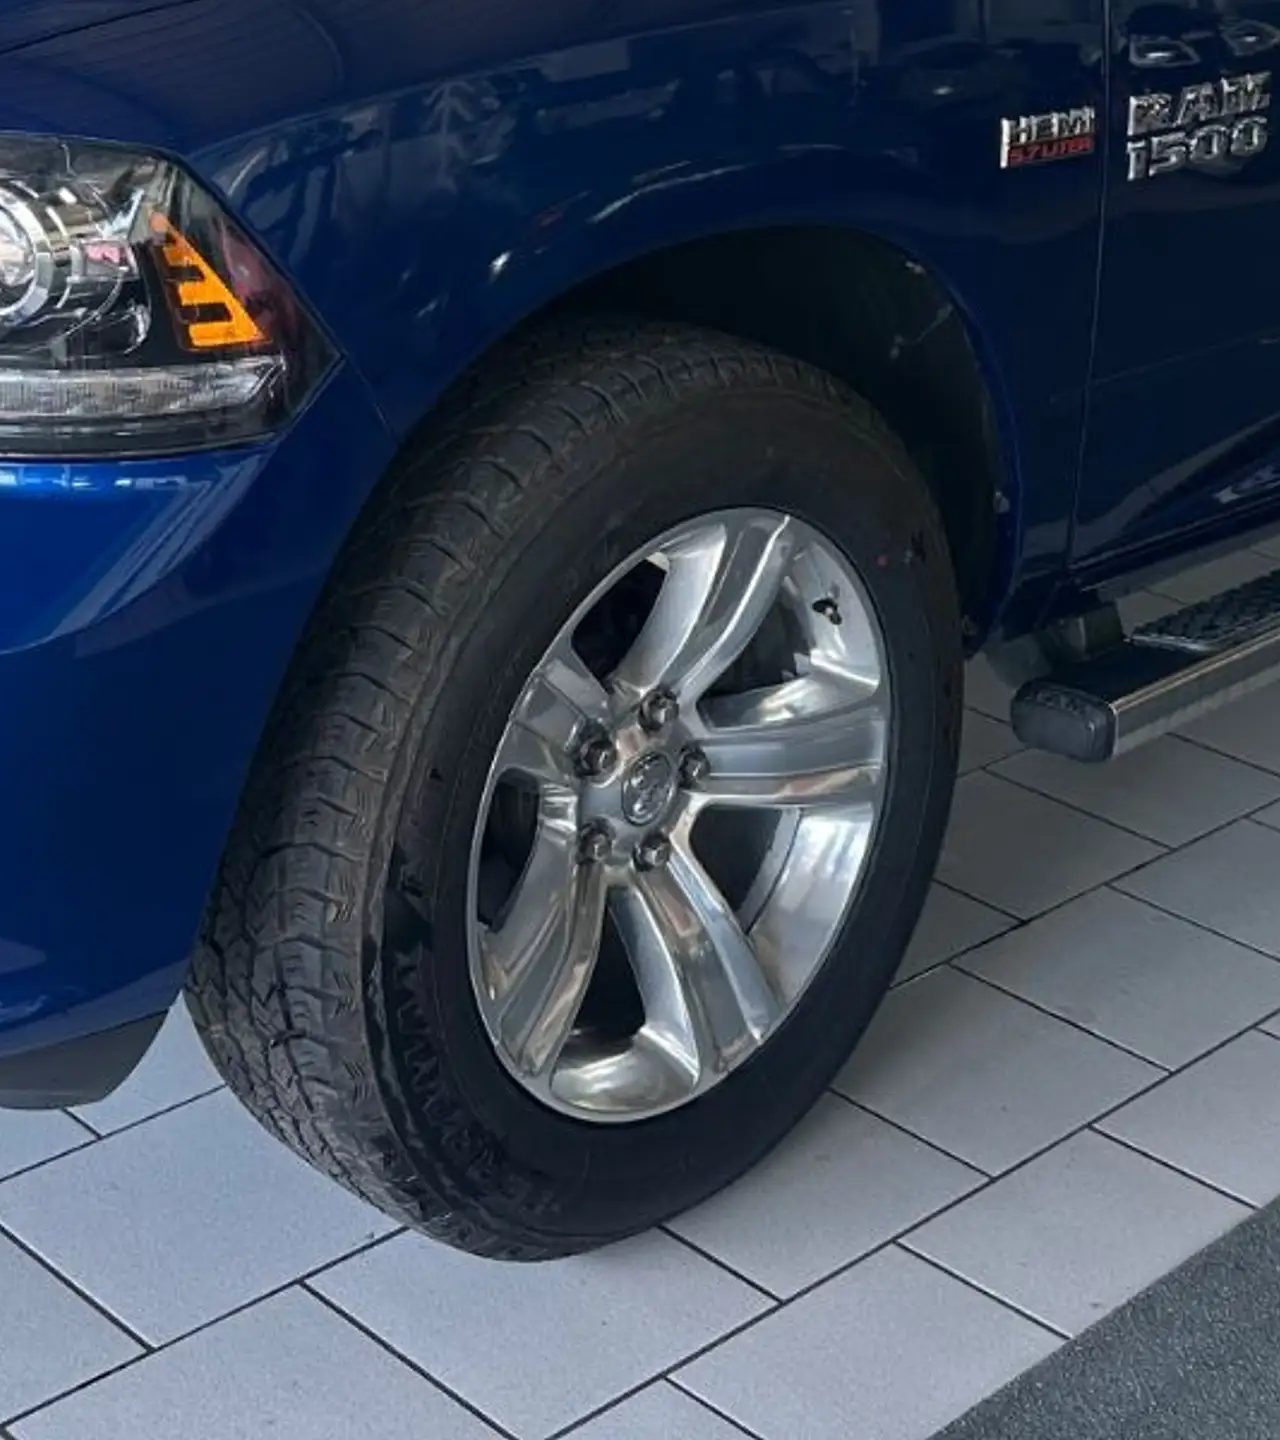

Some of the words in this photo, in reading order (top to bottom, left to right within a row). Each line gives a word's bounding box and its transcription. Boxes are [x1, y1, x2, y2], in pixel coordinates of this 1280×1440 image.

[1001, 106, 1094, 147] HEMI
[1128, 71, 1271, 135] RAM
[1127, 116, 1268, 181] 1500
